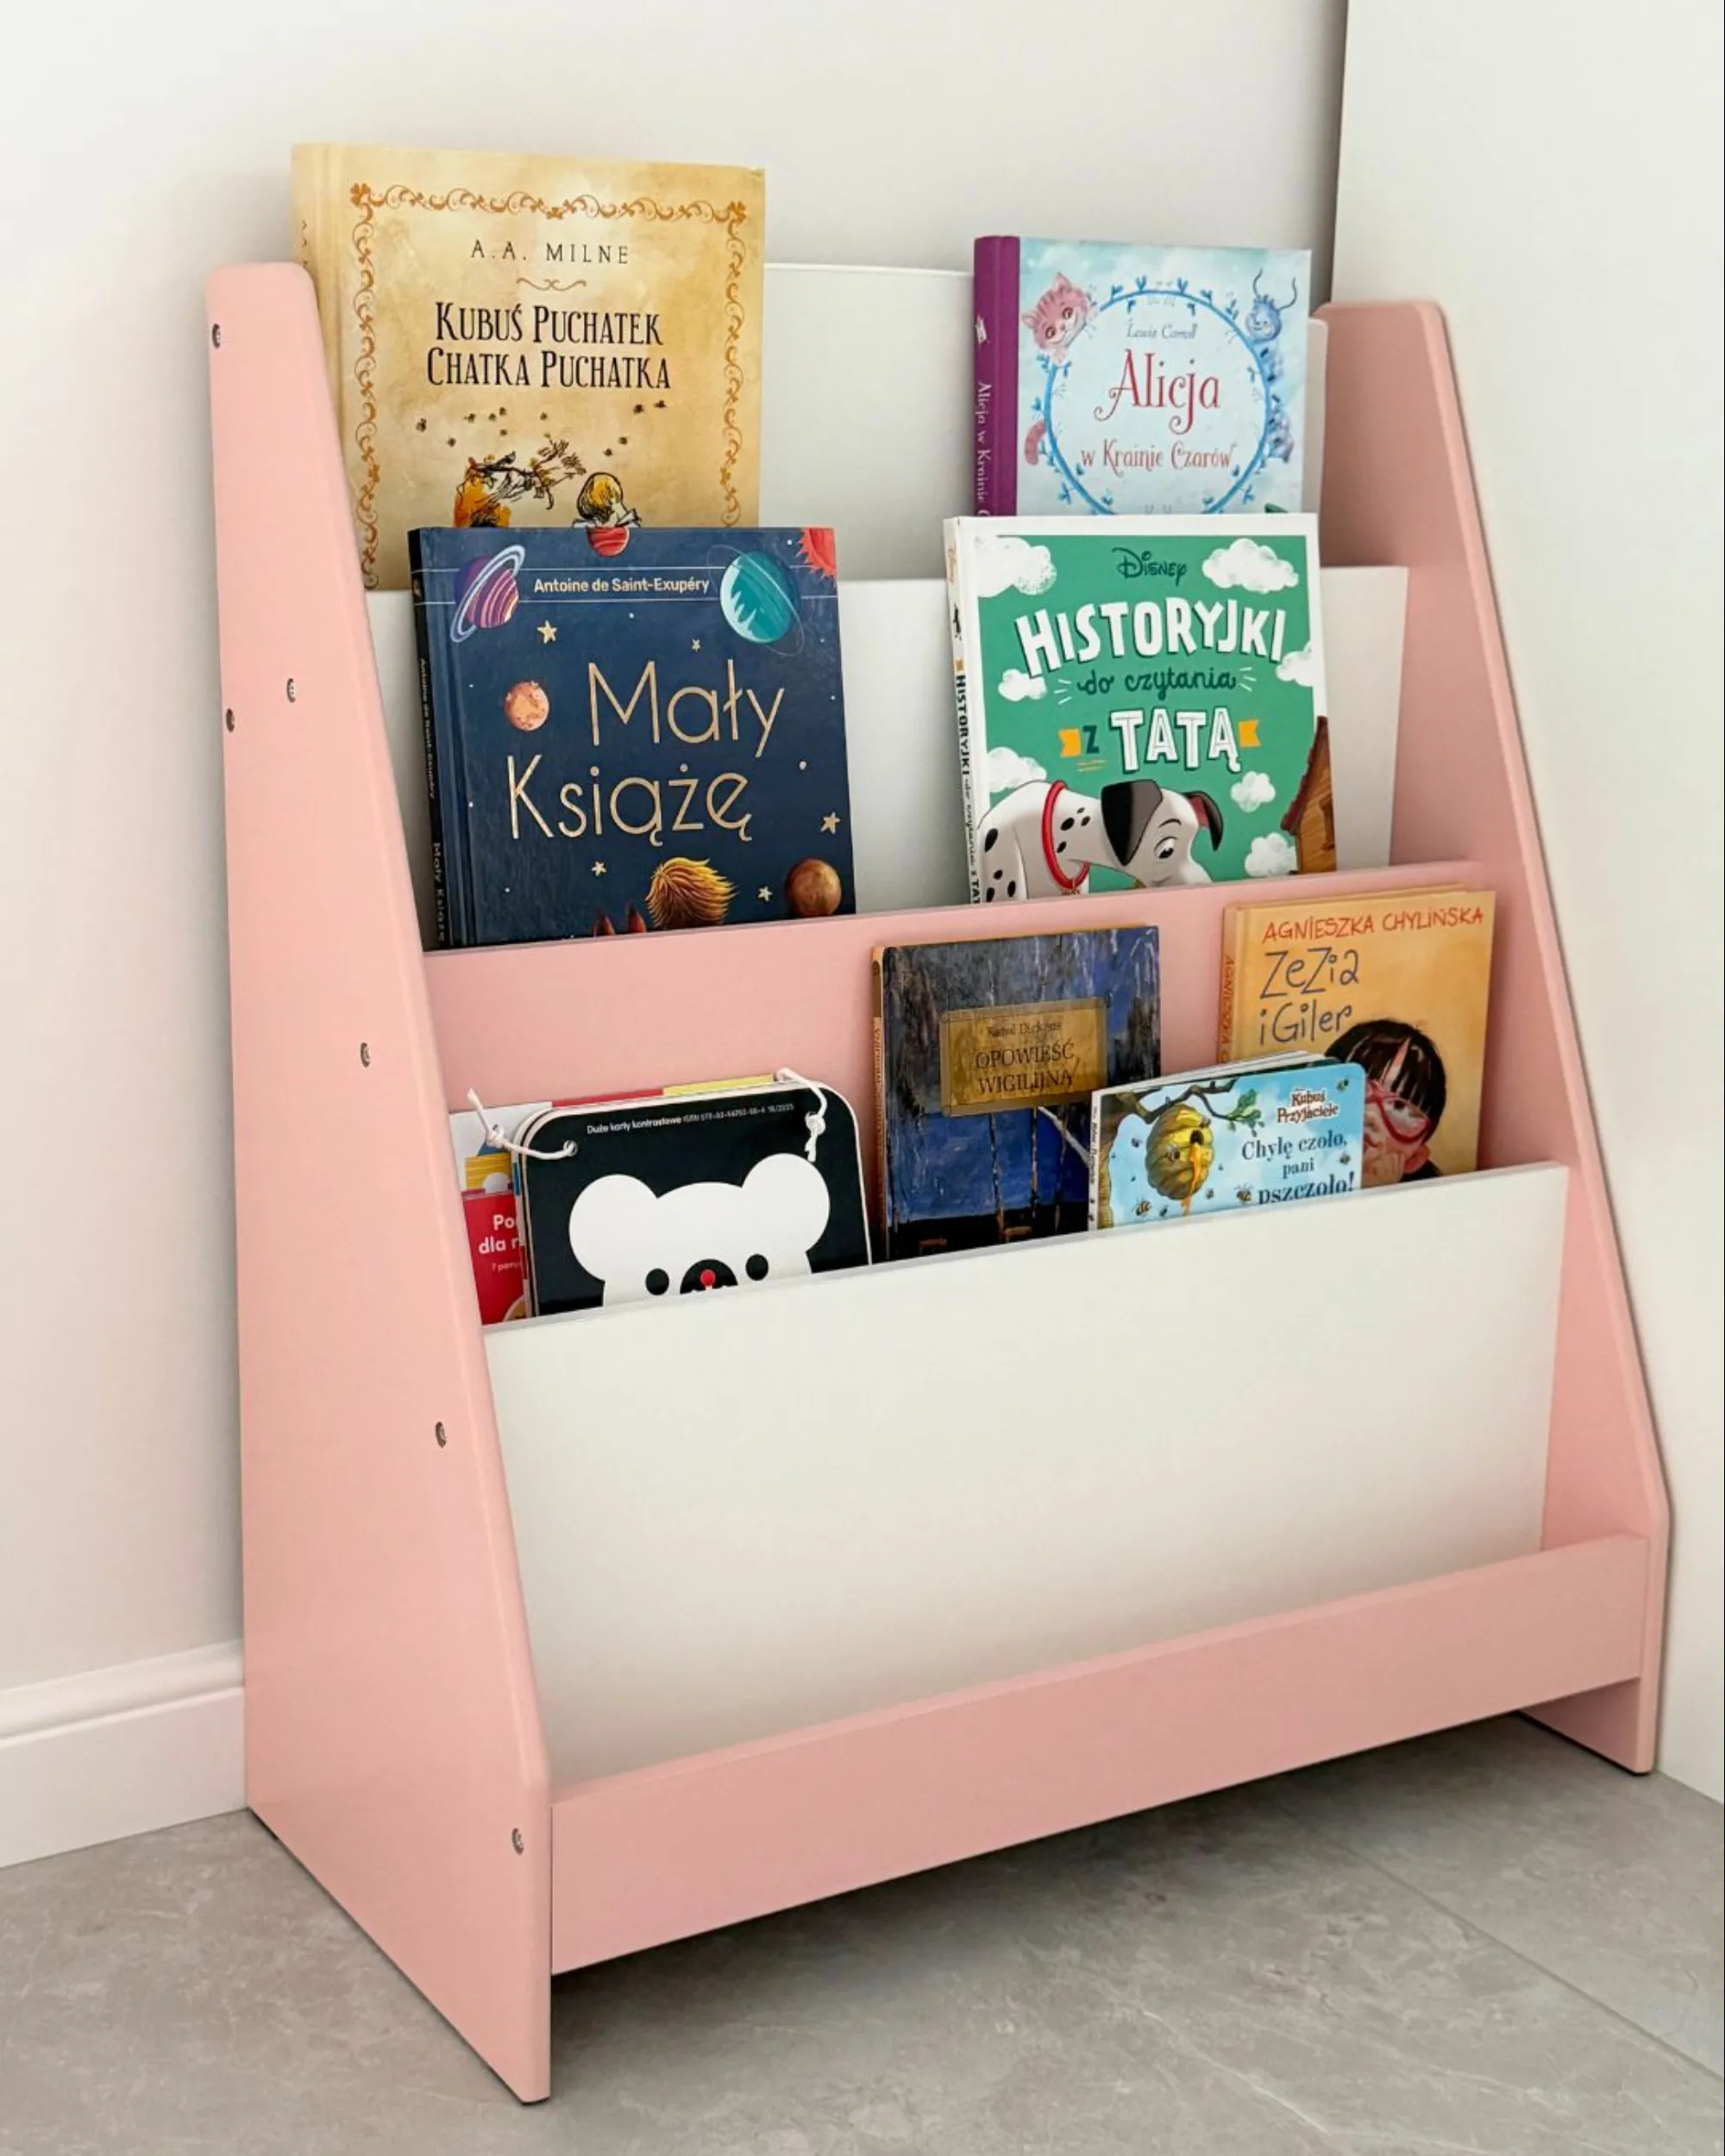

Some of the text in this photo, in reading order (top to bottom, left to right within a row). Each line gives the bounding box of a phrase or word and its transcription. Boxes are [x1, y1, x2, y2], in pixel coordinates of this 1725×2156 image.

[471, 239, 629, 264] A.A. MILNE
[532, 307, 663, 345] PUCHATEK
[427, 347, 670, 390] CHATKA PUCHATKA
[975, 381, 992, 424] Alicja
[1094, 348, 1220, 435] Alicja
[1081, 439, 1237, 477] w Krainie Czarów
[535, 576, 710, 594] Antoine de Saint-Exupéry
[1015, 597, 1287, 679] HISTORYJKI
[1077, 667, 1237, 701] do czytania
[588, 659, 785, 758] Mały
[956, 674, 969, 776] HISTORYJKI
[1110, 706, 1242, 774] TATĄ
[507, 754, 752, 848] Książę
[1262, 907, 1484, 944] AGNIESZKA CHYLIŃSKA
[975, 1038, 1075, 1069] OPOWIEŚĆ
[1242, 1137, 1293, 1162] Chylę
[1283, 1157, 1314, 1179] pani
[478, 1236, 506, 1254] dla
